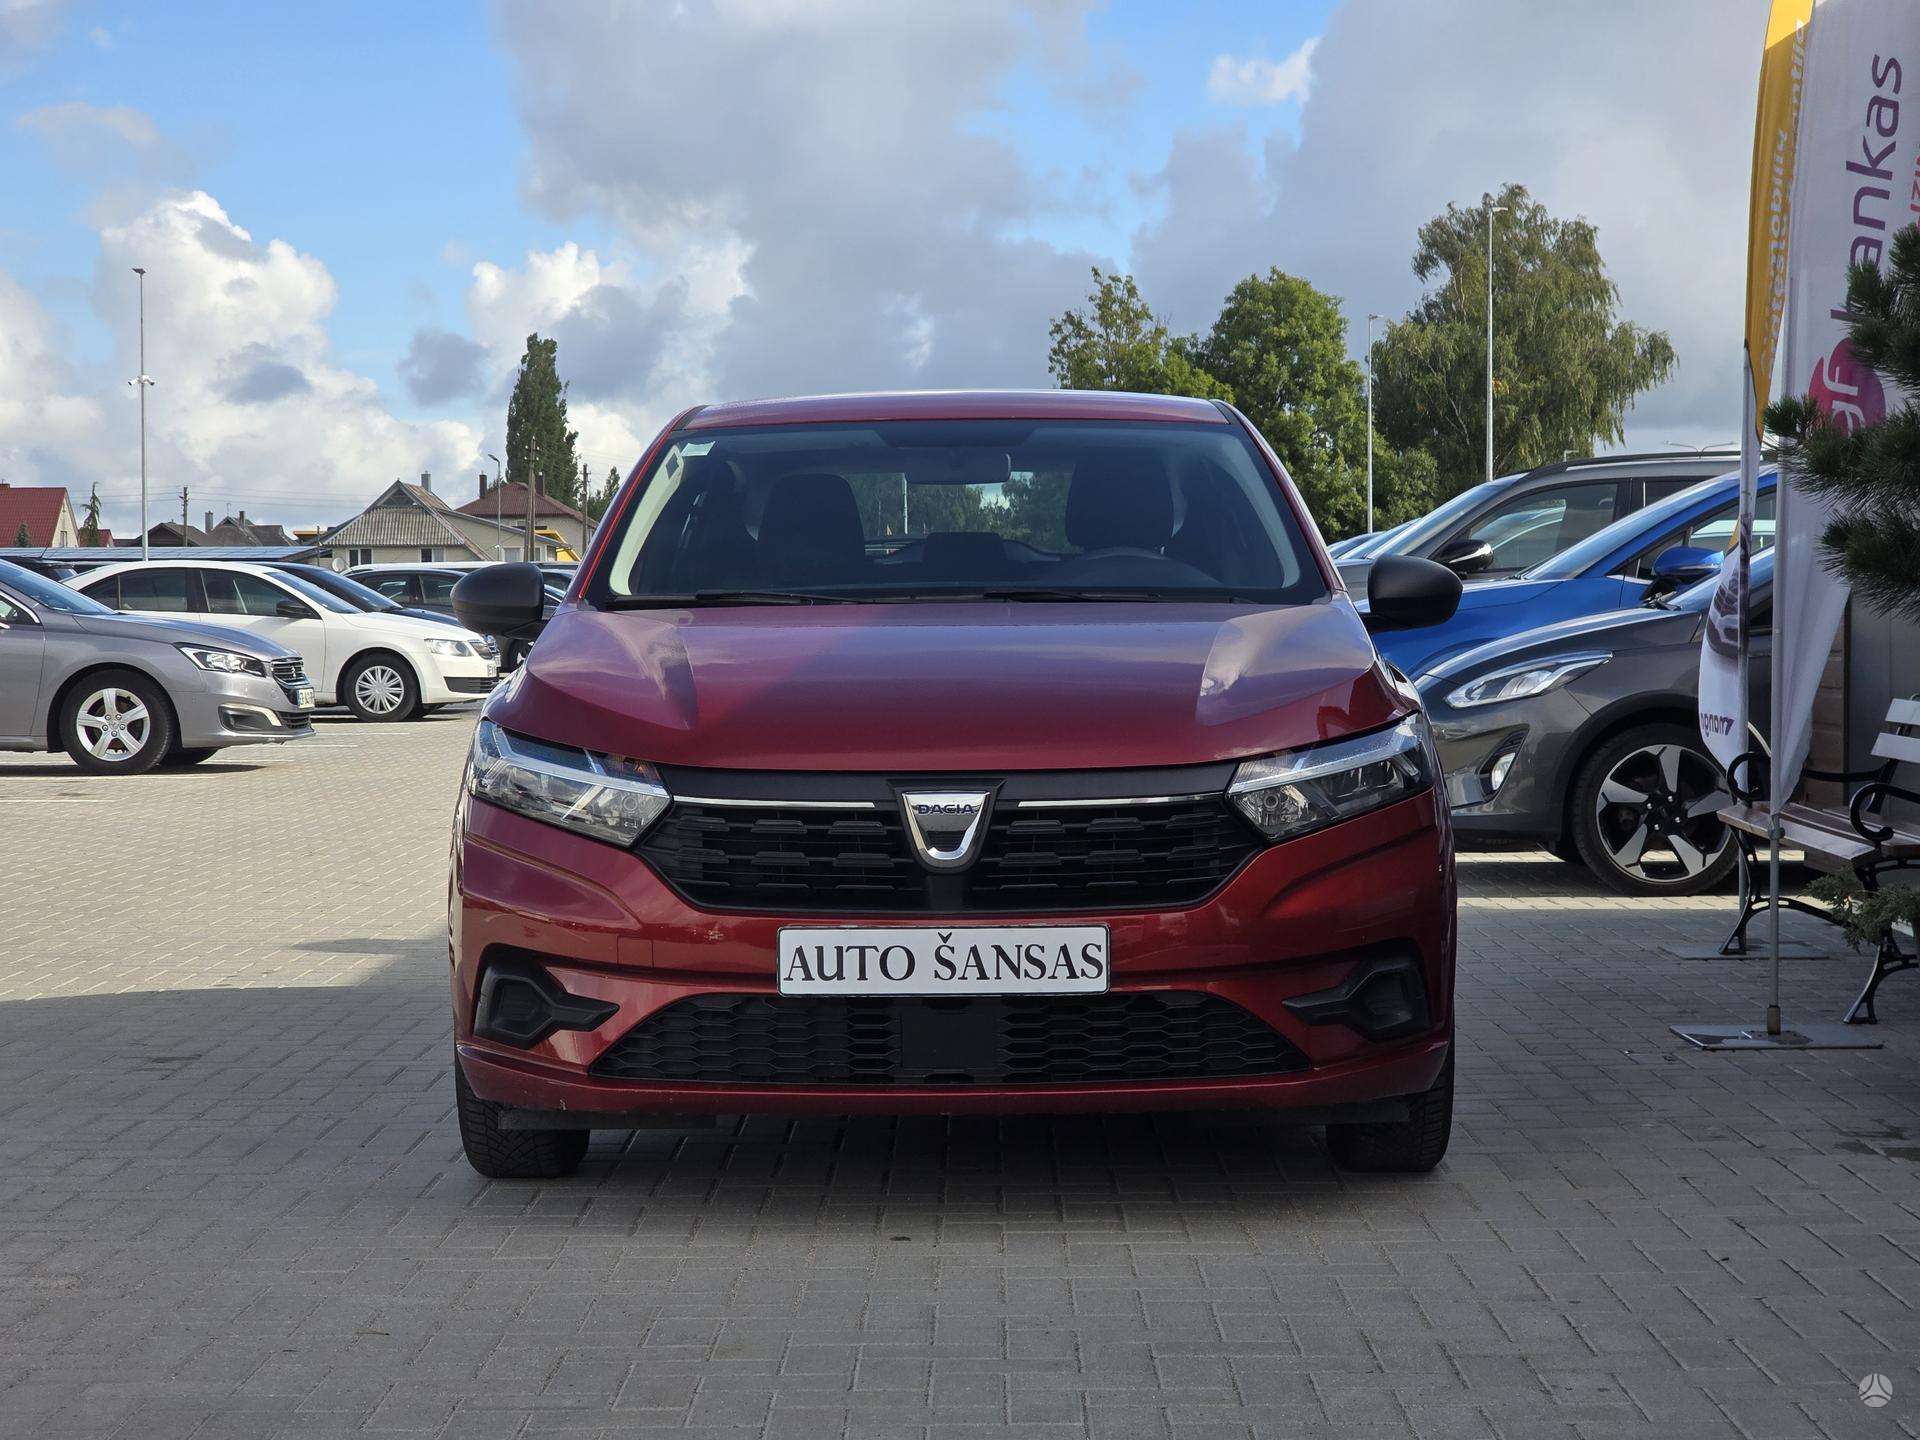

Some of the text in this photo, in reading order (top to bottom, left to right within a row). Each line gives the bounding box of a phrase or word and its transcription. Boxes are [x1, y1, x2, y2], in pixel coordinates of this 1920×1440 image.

[917, 803, 975, 815] DACIA
[783, 931, 1103, 982] AUTO ŠANSAS
